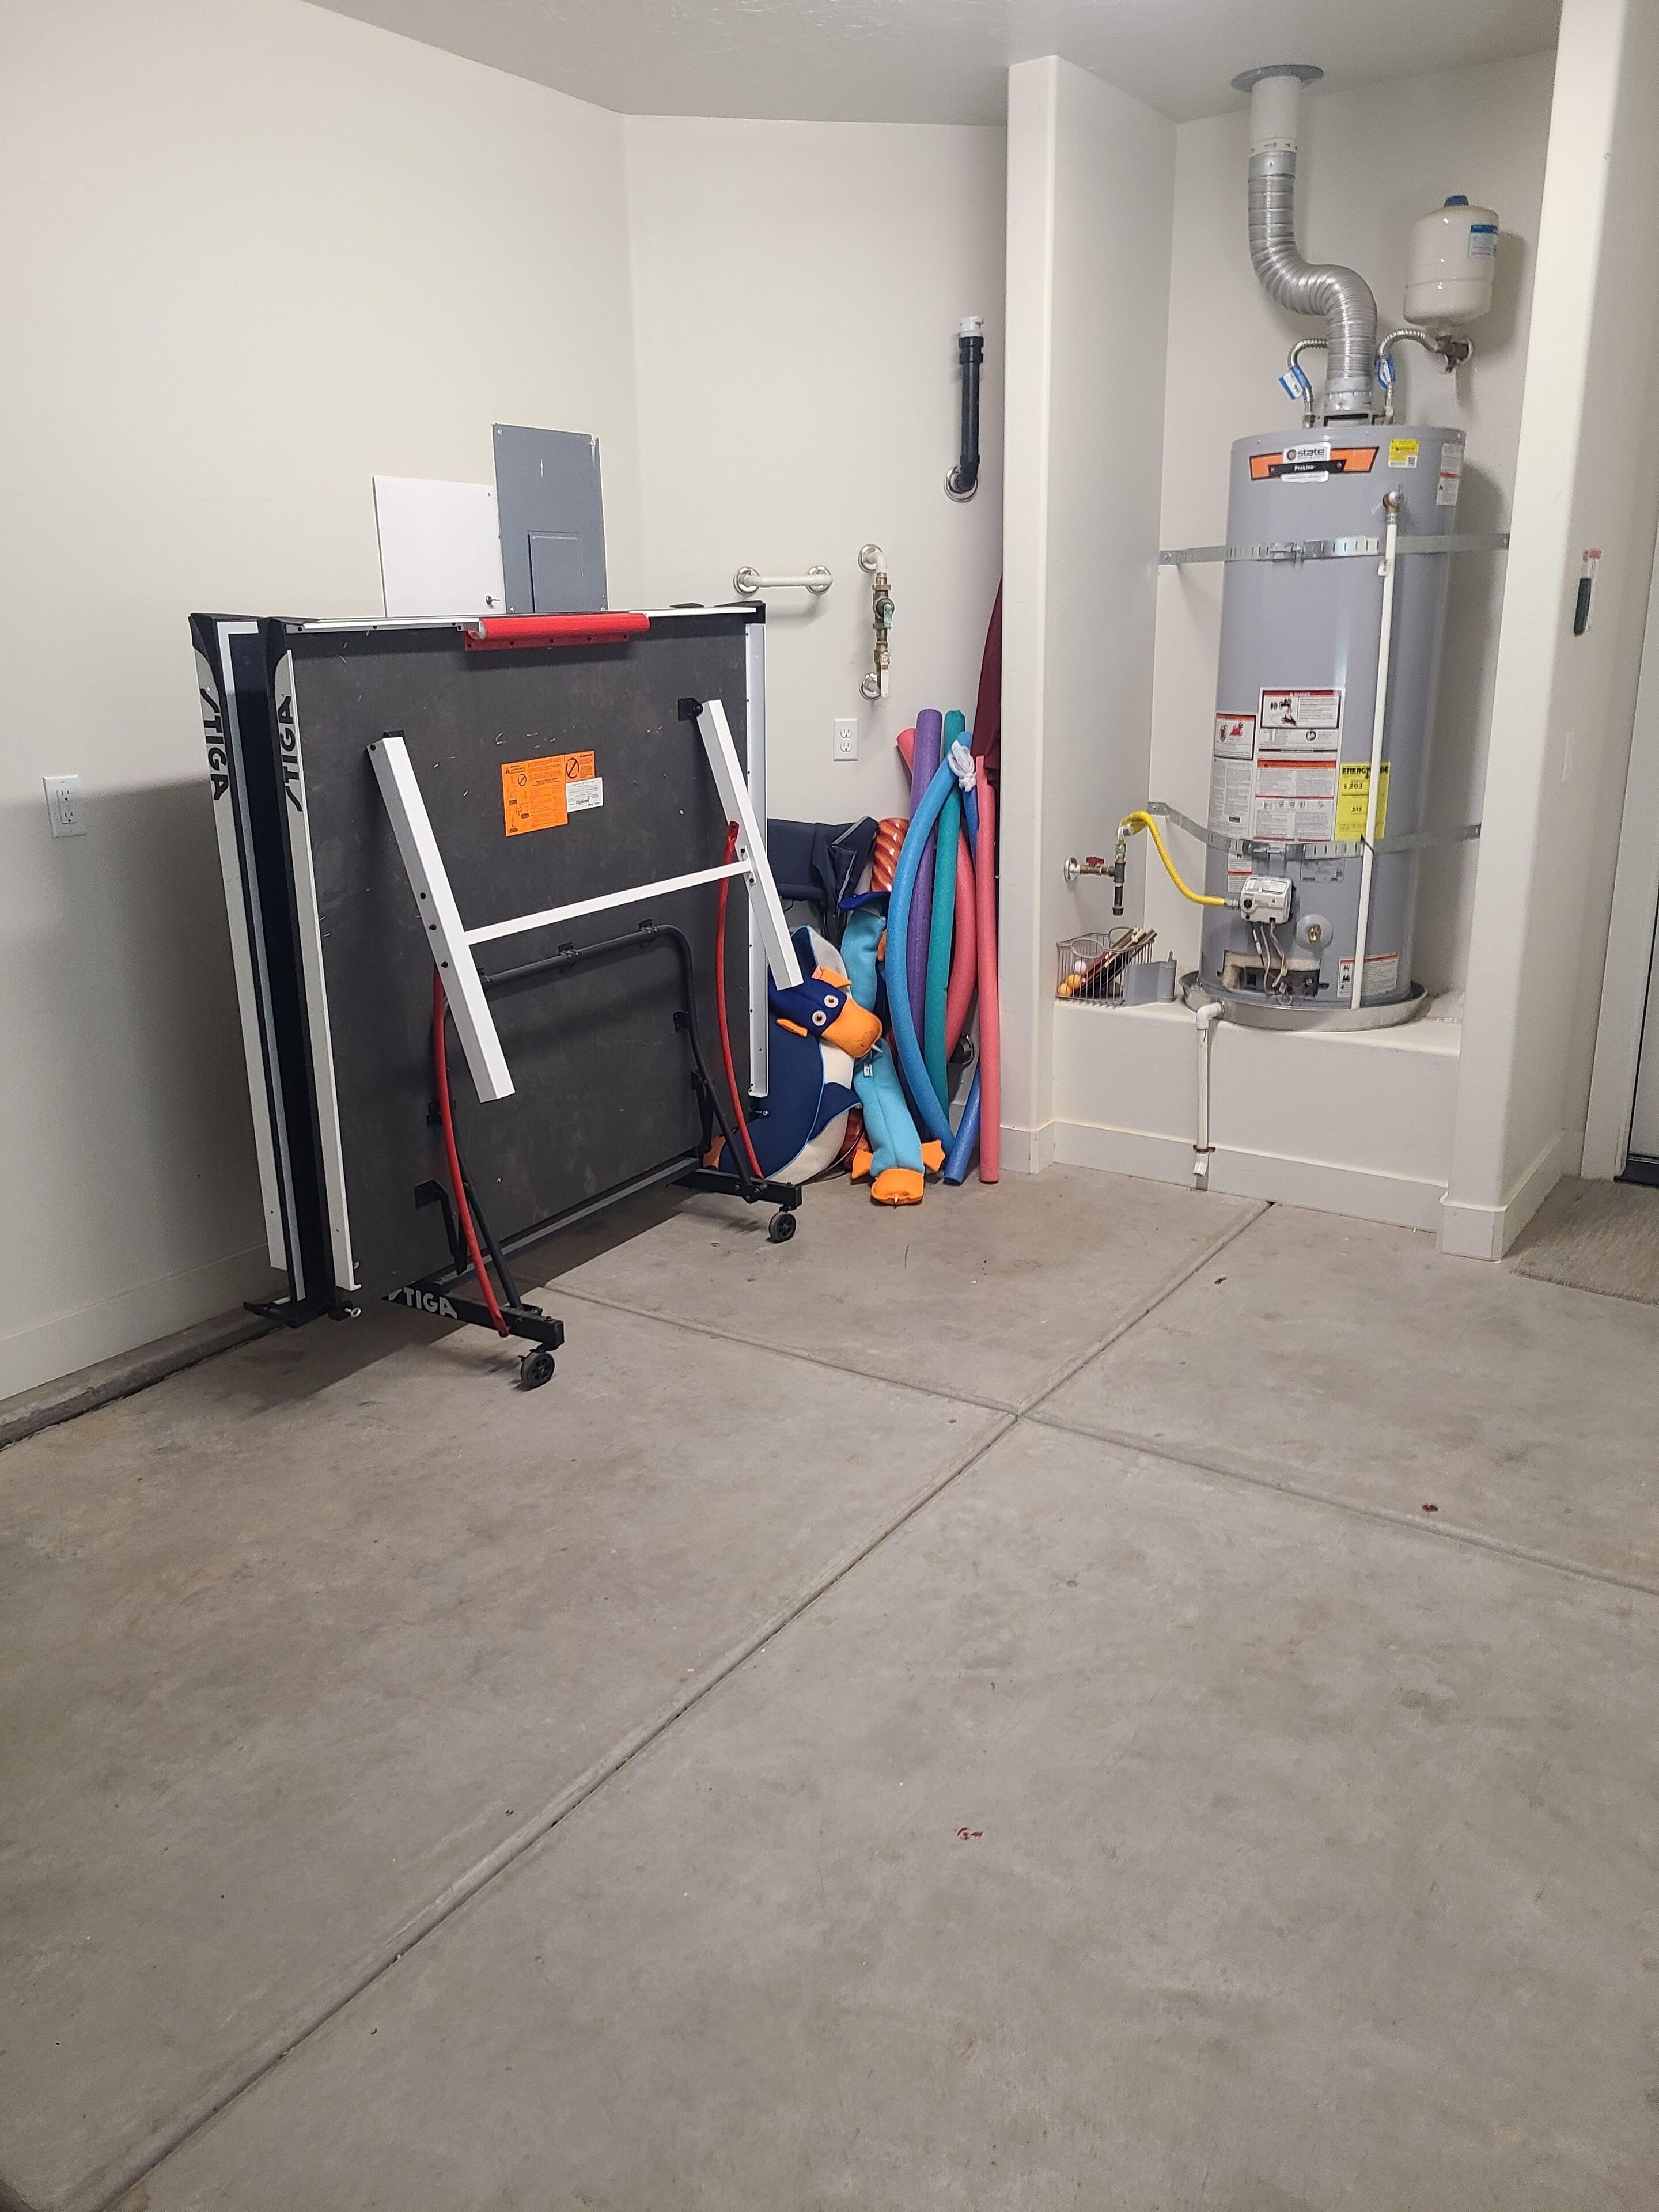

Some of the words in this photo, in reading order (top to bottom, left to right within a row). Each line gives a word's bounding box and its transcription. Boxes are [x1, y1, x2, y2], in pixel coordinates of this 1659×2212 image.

[1297, 448, 1325, 457] state
[200, 688, 229, 800] STIGA
[278, 695, 304, 812] STIGA
[388, 1287, 457, 1320] STIGA
